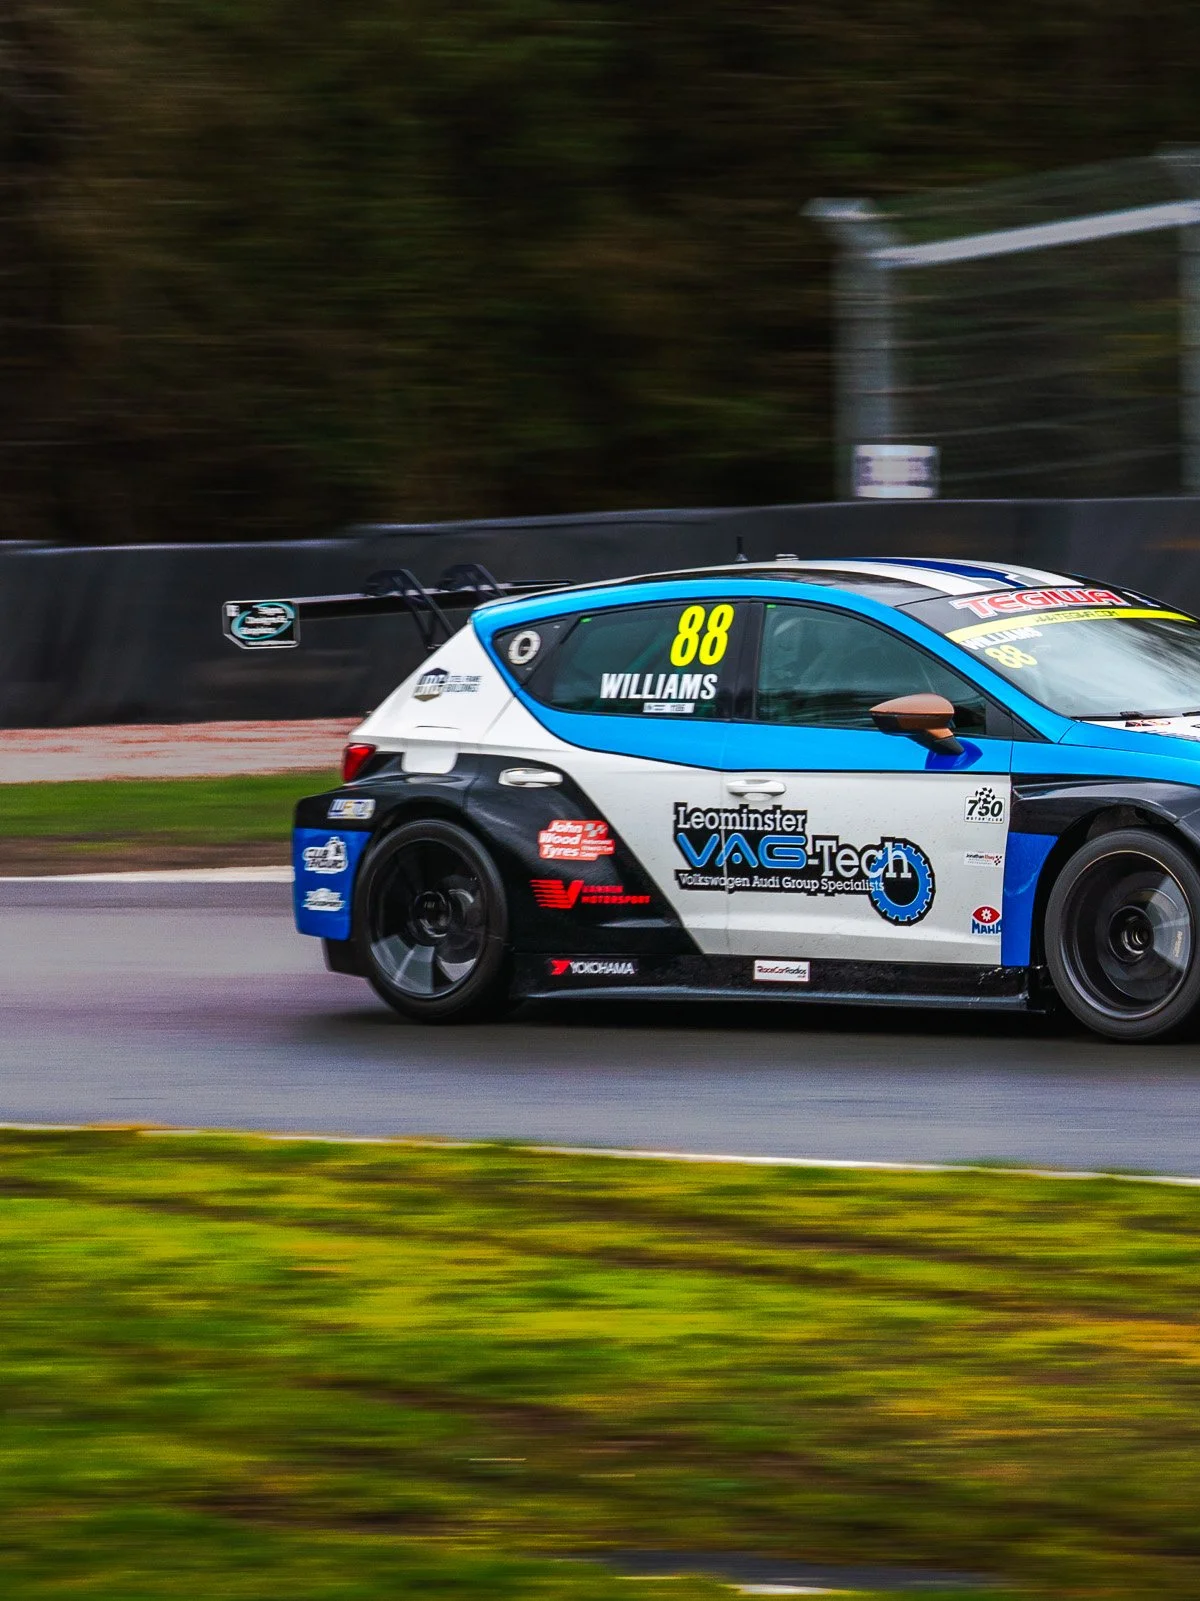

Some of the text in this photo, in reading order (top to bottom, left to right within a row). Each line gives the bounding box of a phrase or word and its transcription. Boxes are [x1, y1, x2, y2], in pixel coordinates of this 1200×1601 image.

[952, 589, 1129, 618] TEGIWA
[670, 604, 735, 667] 88
[960, 627, 1042, 650] WILLIAMS
[985, 645, 1037, 668] 88
[600, 673, 718, 700] WILLIAMS
[967, 799, 1003, 817] 750
[548, 822, 583, 833] John
[677, 806, 805, 832] Leominster
[539, 832, 582, 845] Wood
[542, 844, 580, 858] Tyres
[678, 873, 884, 892] Volkswagen Audi Group Specialists
[581, 895, 651, 904] MOTORSPORT
[569, 961, 635, 974] YOKOHAMA
